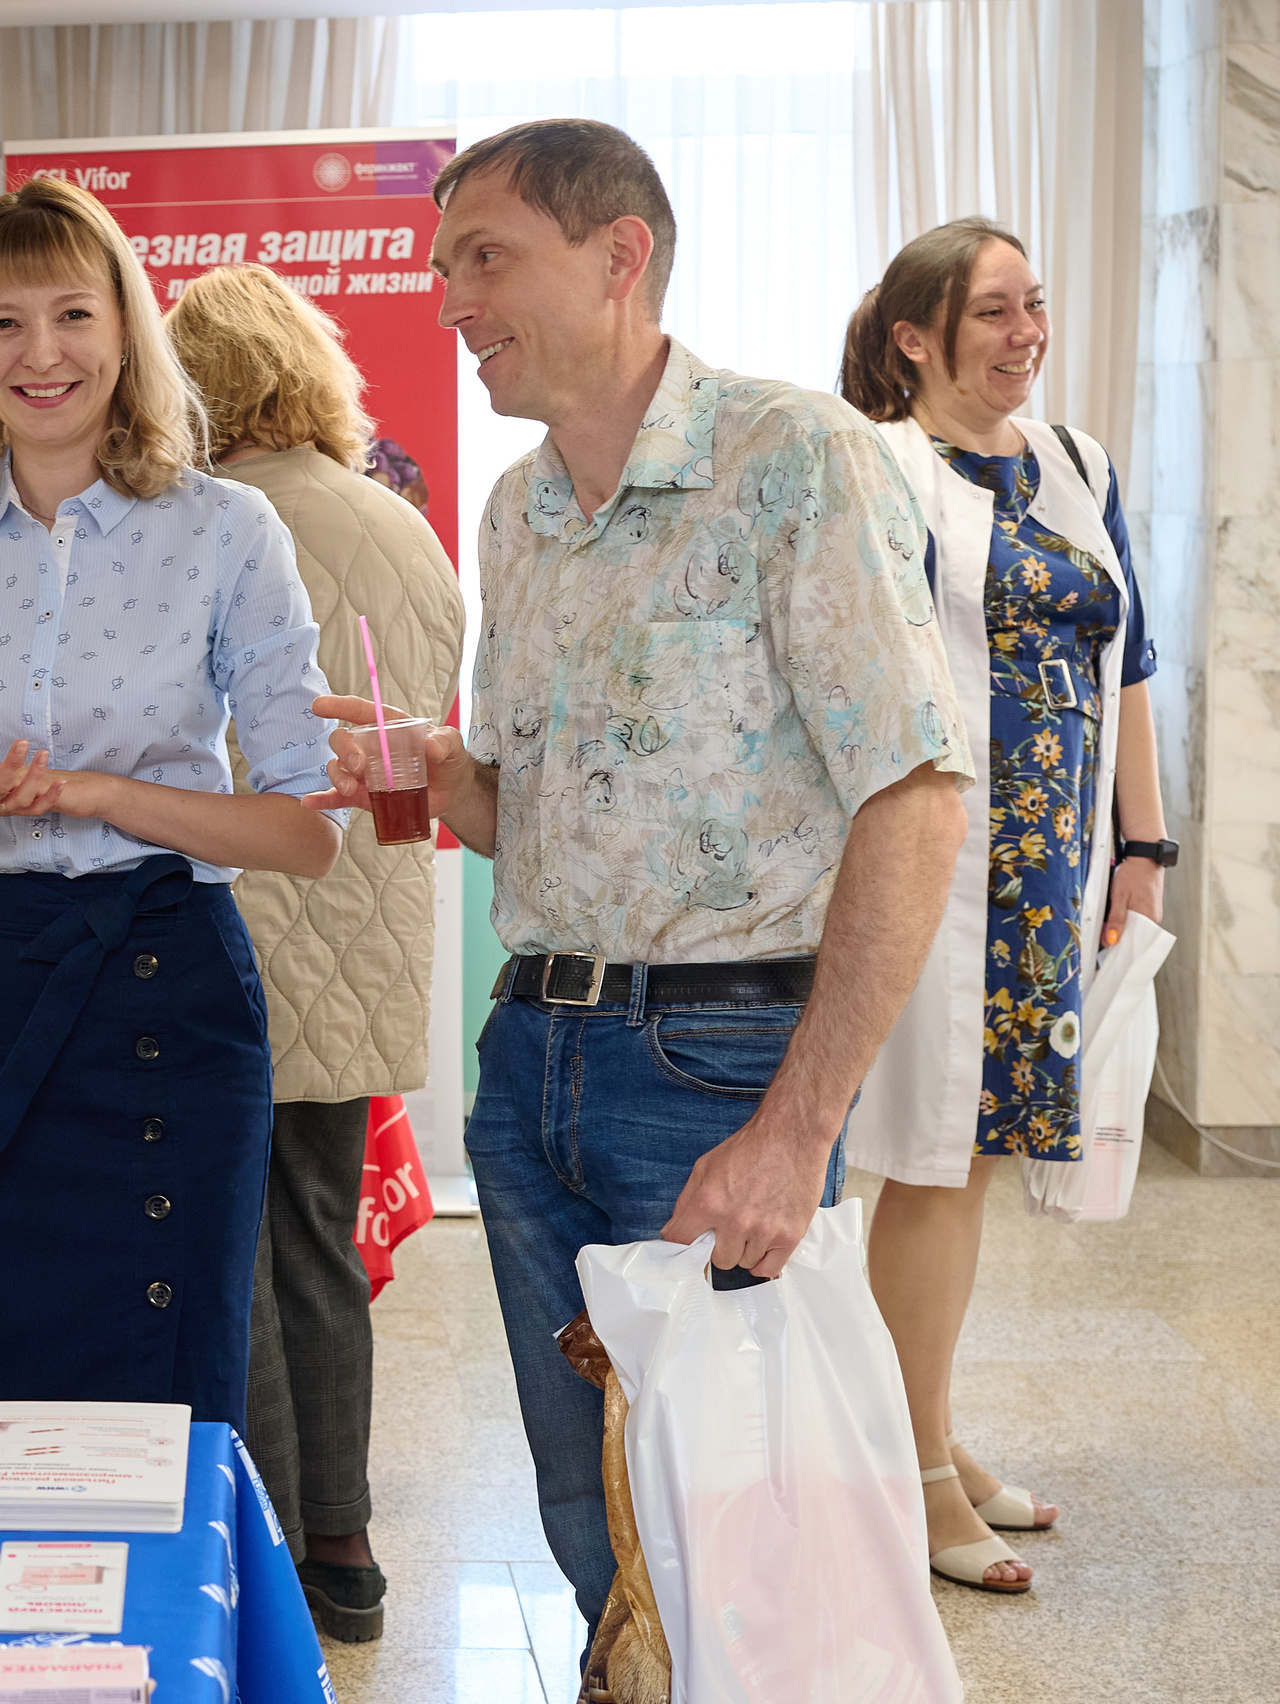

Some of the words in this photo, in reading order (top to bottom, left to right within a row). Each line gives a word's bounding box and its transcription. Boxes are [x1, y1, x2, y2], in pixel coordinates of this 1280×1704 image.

[74, 166, 132, 191] Vifor
[258, 227, 415, 269] защита
[345, 271, 433, 295] жизни
